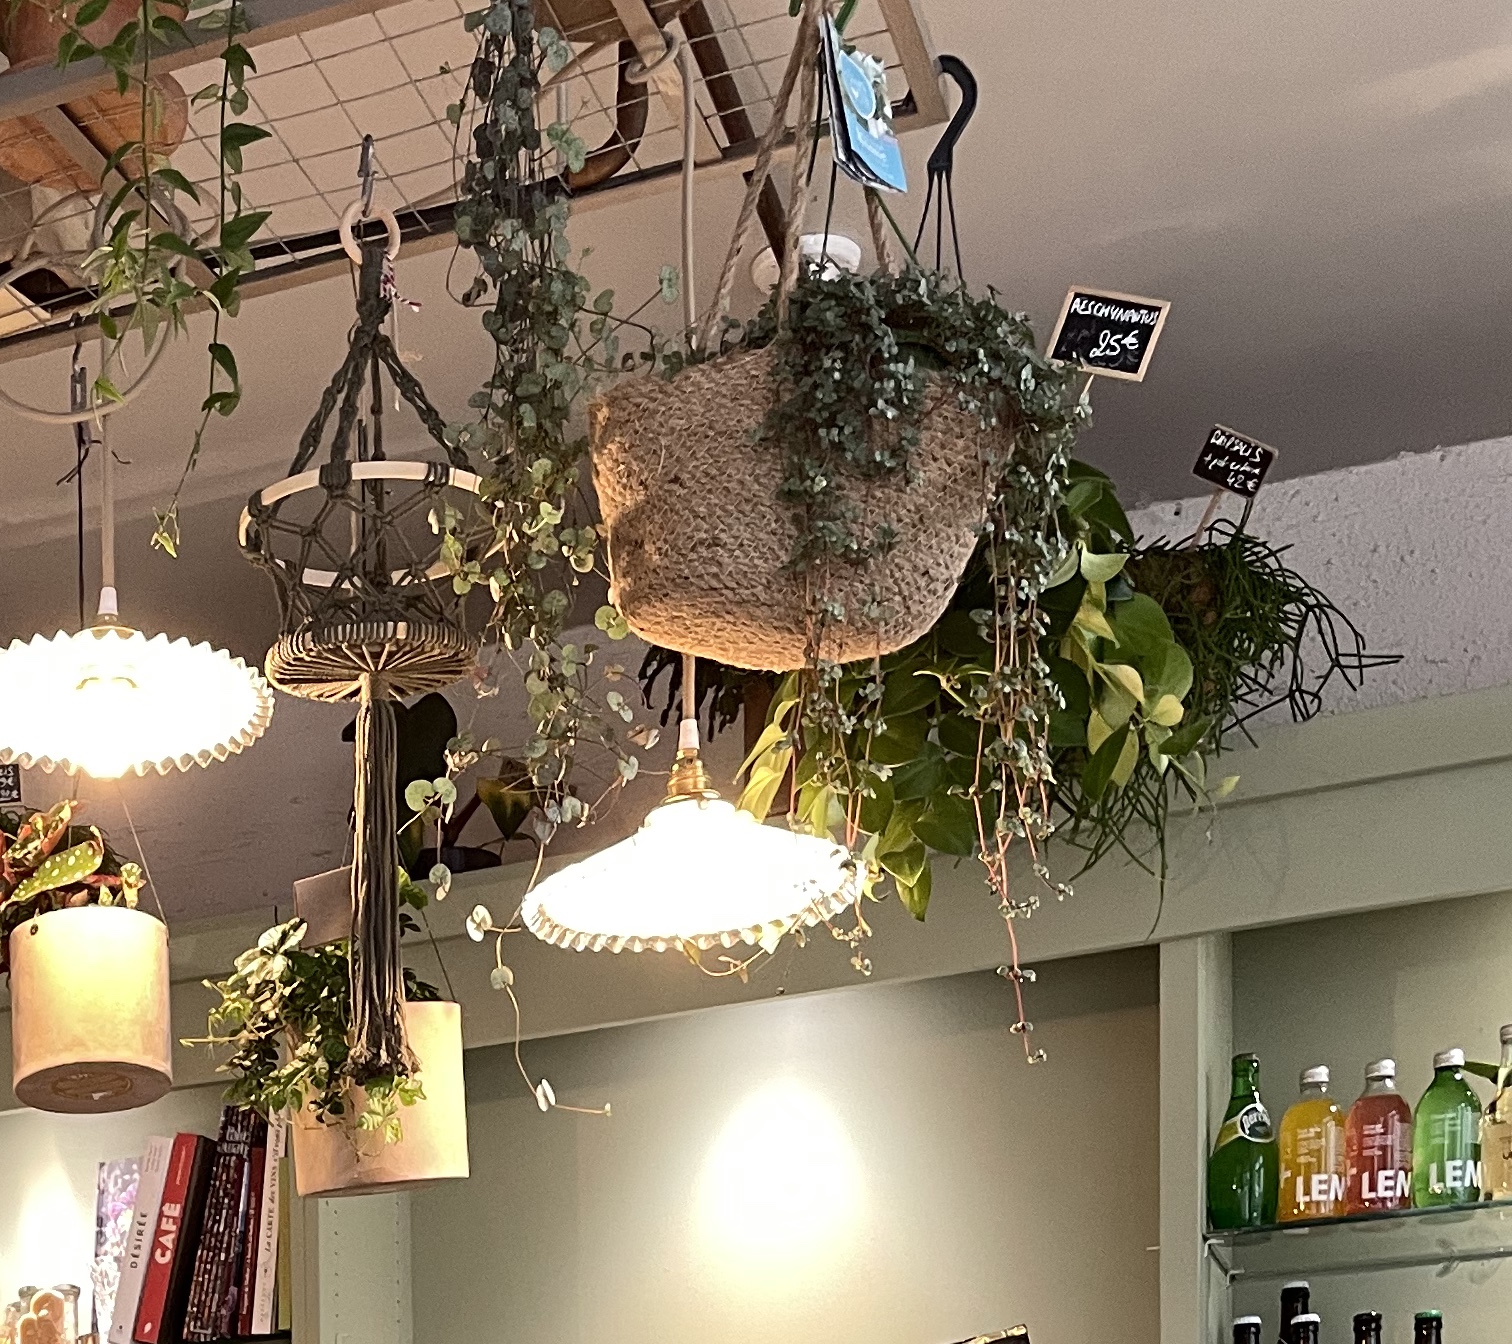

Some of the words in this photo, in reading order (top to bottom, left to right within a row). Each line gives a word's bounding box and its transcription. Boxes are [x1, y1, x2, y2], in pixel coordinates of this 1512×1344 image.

[1089, 330, 1139, 358] 25€
[155, 1202, 181, 1264] CAFÉ
[265, 1207, 275, 1238] CARTE
